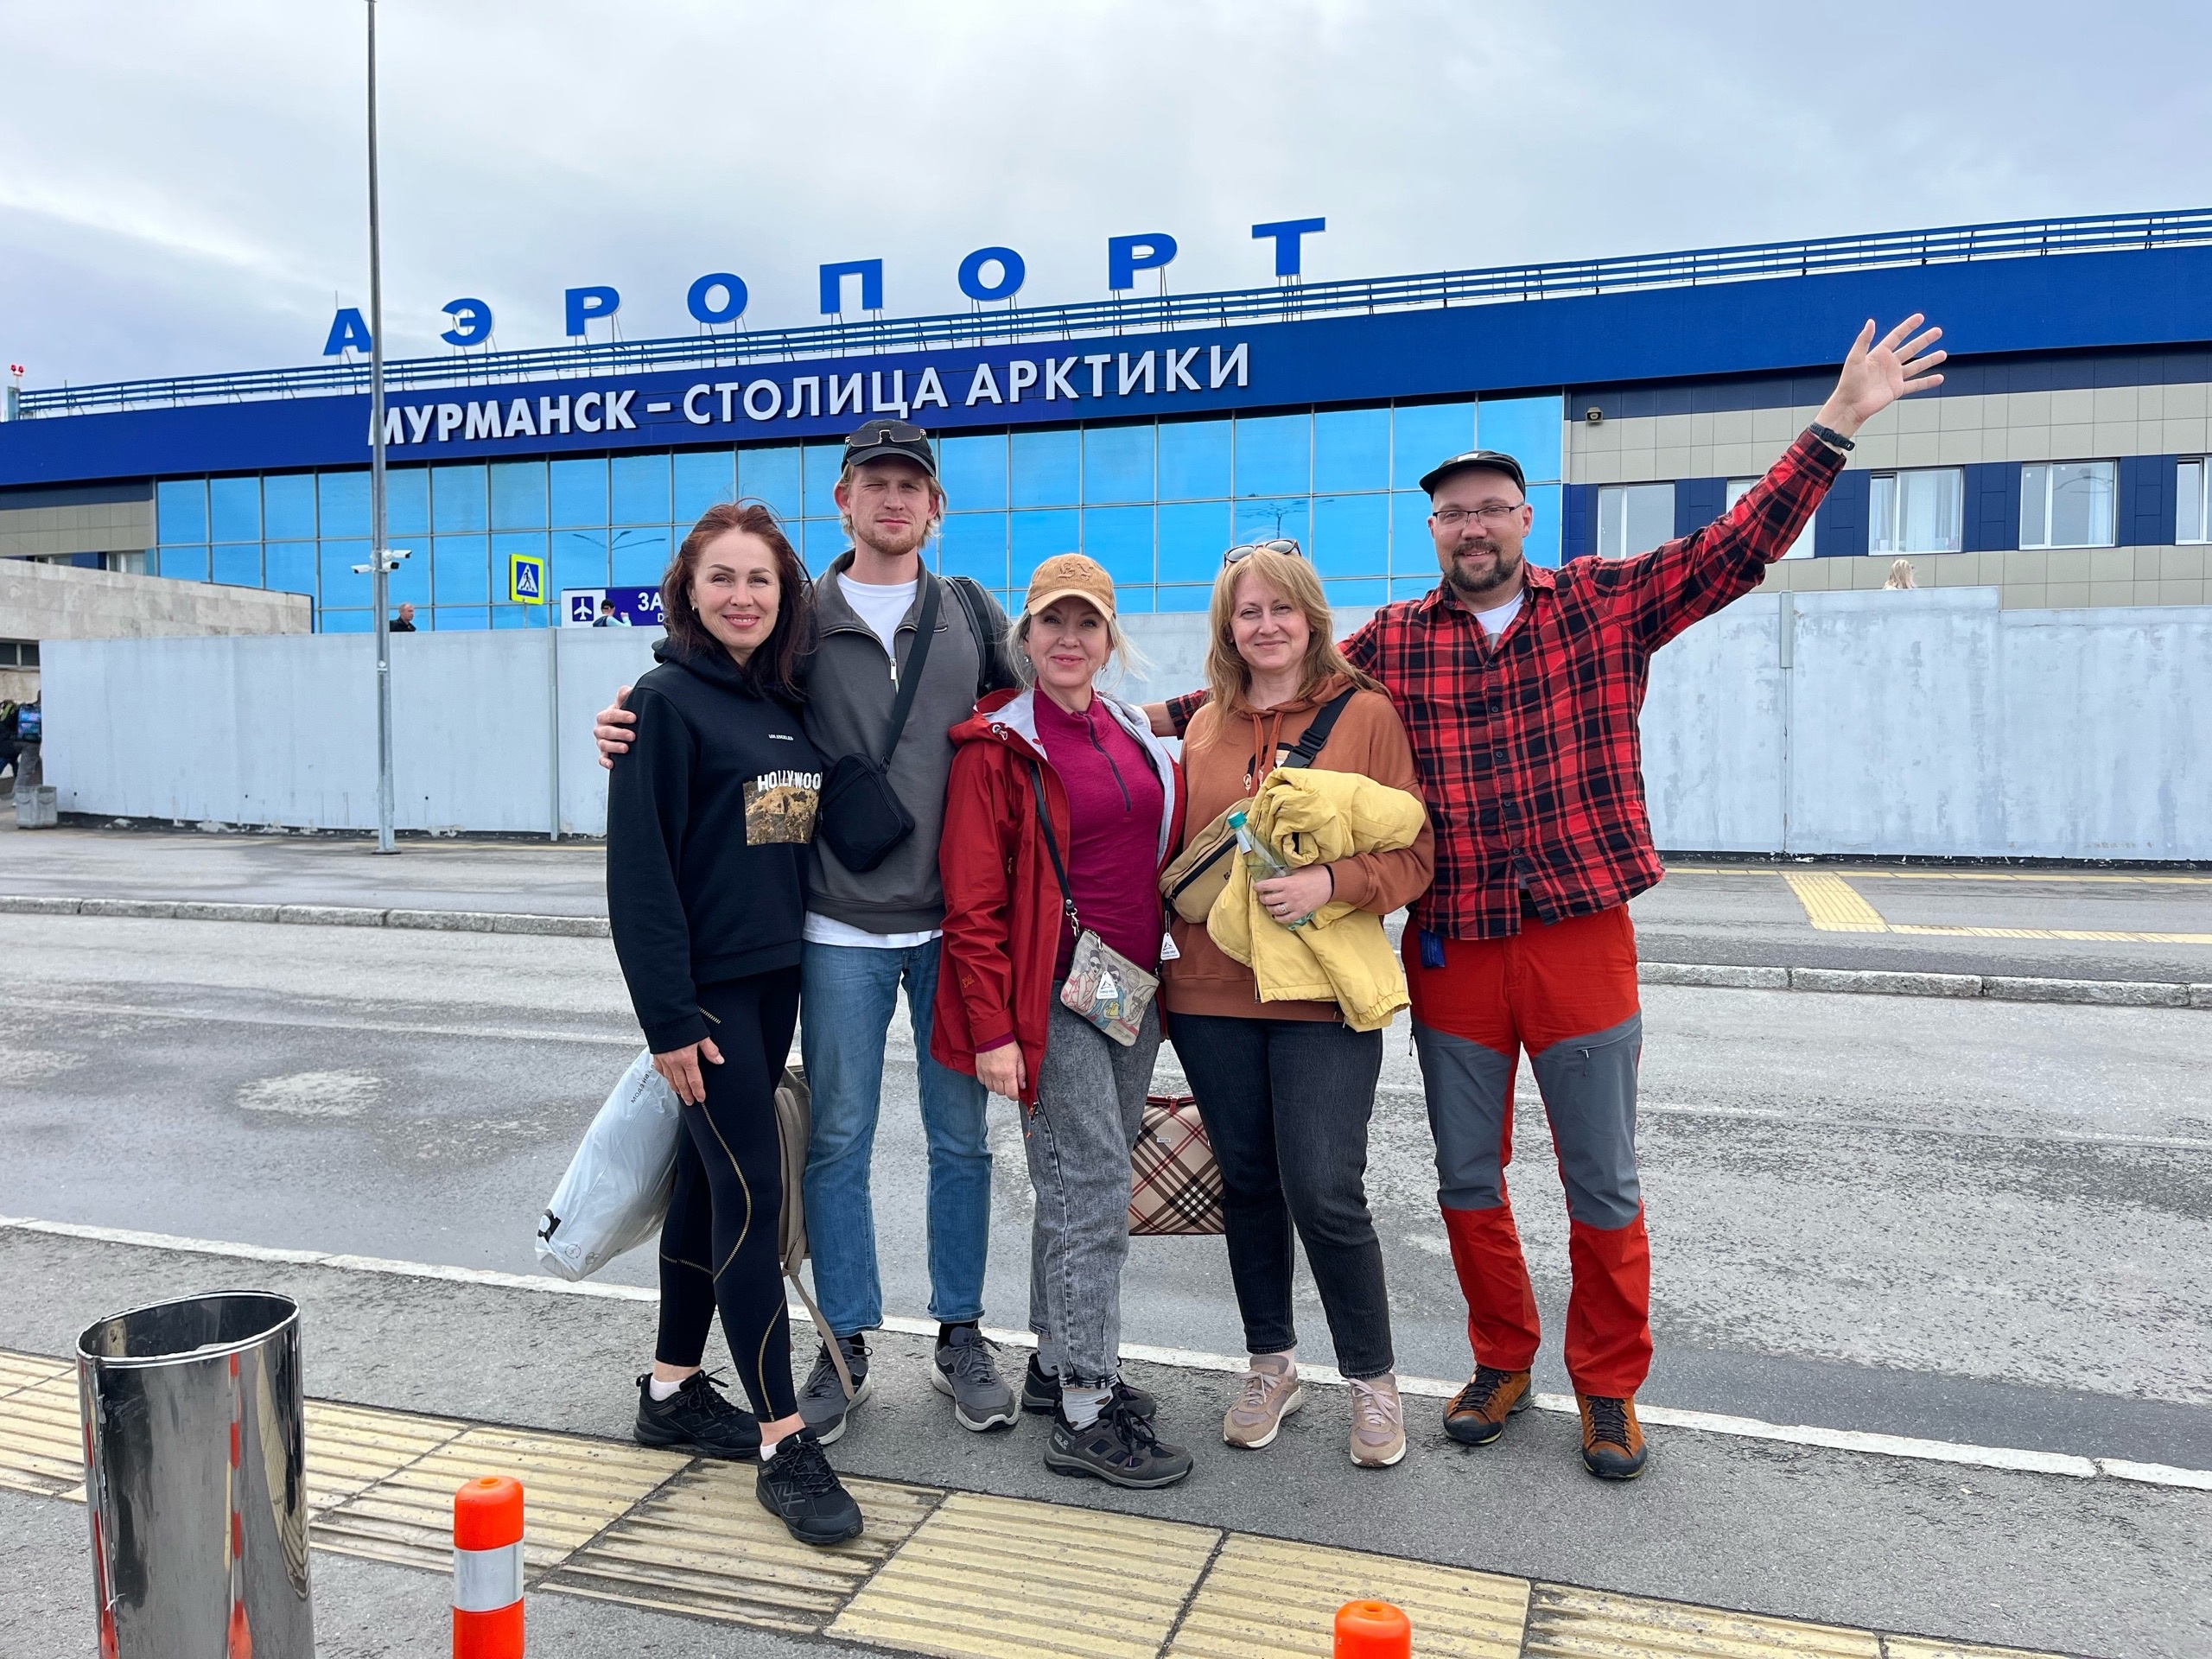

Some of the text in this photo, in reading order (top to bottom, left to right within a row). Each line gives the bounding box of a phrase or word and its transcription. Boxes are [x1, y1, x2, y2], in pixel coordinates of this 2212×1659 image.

[322, 216, 1326, 356] АЭРОПОРТ
[368, 390, 638, 446] МУРМАНСК
[683, 366, 949, 424] СТОЛИЦА
[964, 342, 1249, 407] АРКТИКИ
[757, 770, 823, 791] HOLLYWOO
